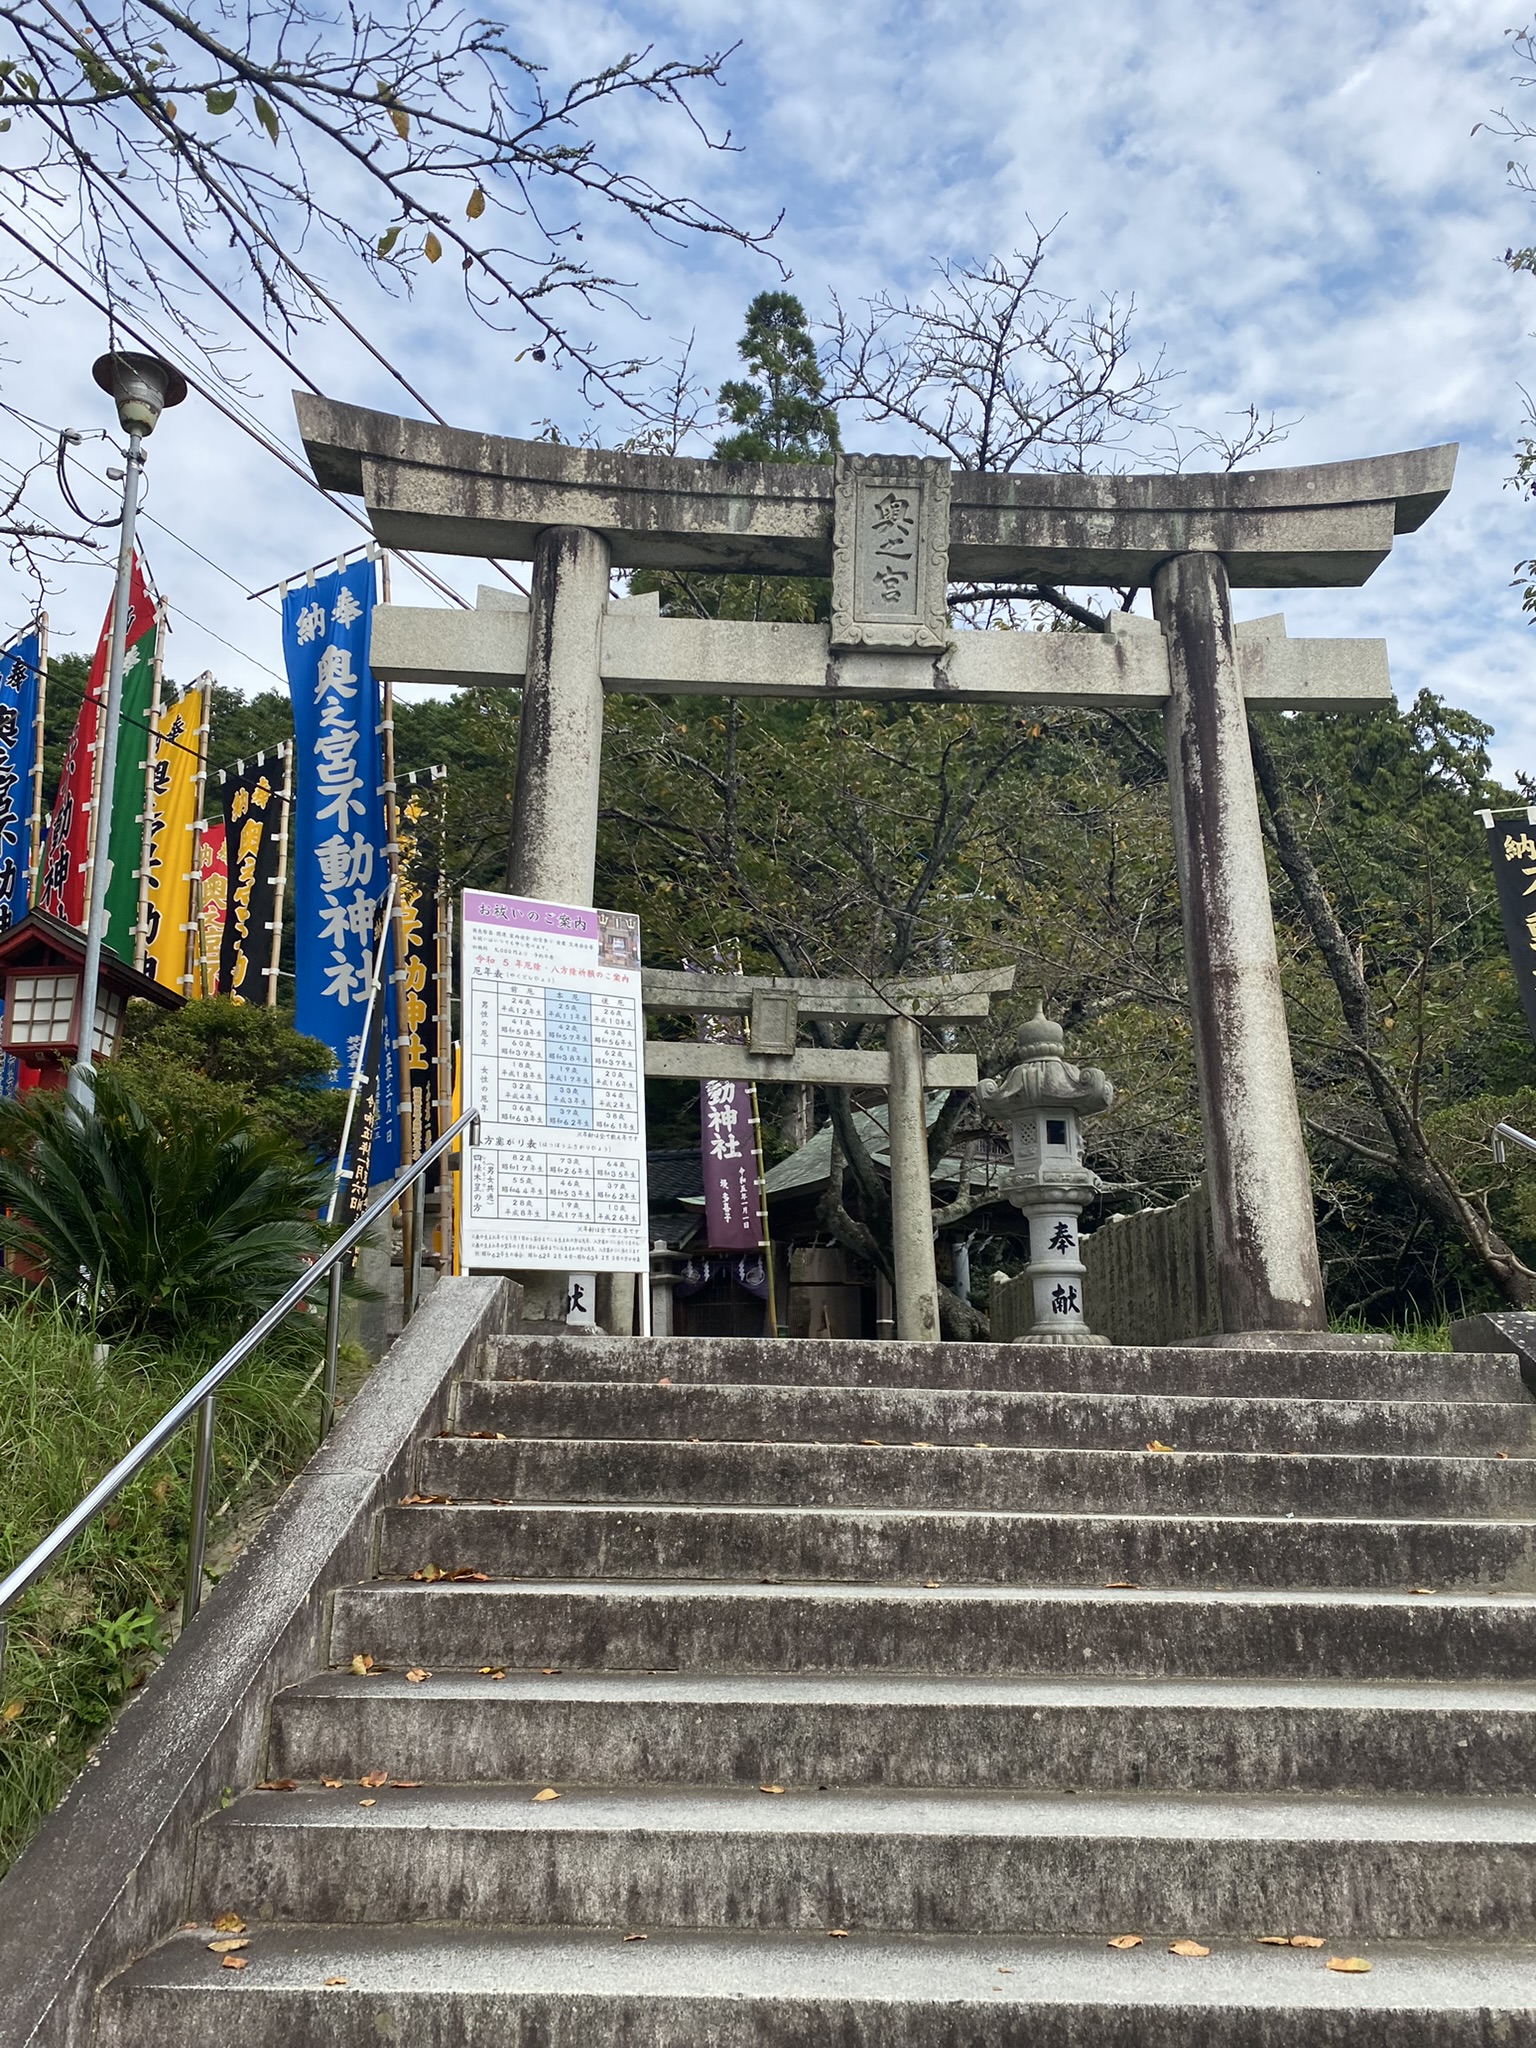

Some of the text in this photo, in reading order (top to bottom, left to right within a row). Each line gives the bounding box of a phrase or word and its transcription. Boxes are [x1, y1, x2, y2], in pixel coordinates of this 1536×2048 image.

[872, 492, 914, 604] 奥之宮
[296, 586, 363, 646] 奉納
[314, 643, 374, 1008] 奥之宮不動神社
[477, 902, 589, 934] お祓いのご案内
[479, 1000, 489, 1047] 男性の厄年
[479, 1065, 489, 1113] 女性の厄年
[738, 1166, 750, 1230] 令和五年一月一日
[1048, 1221, 1081, 1315] 奉献
